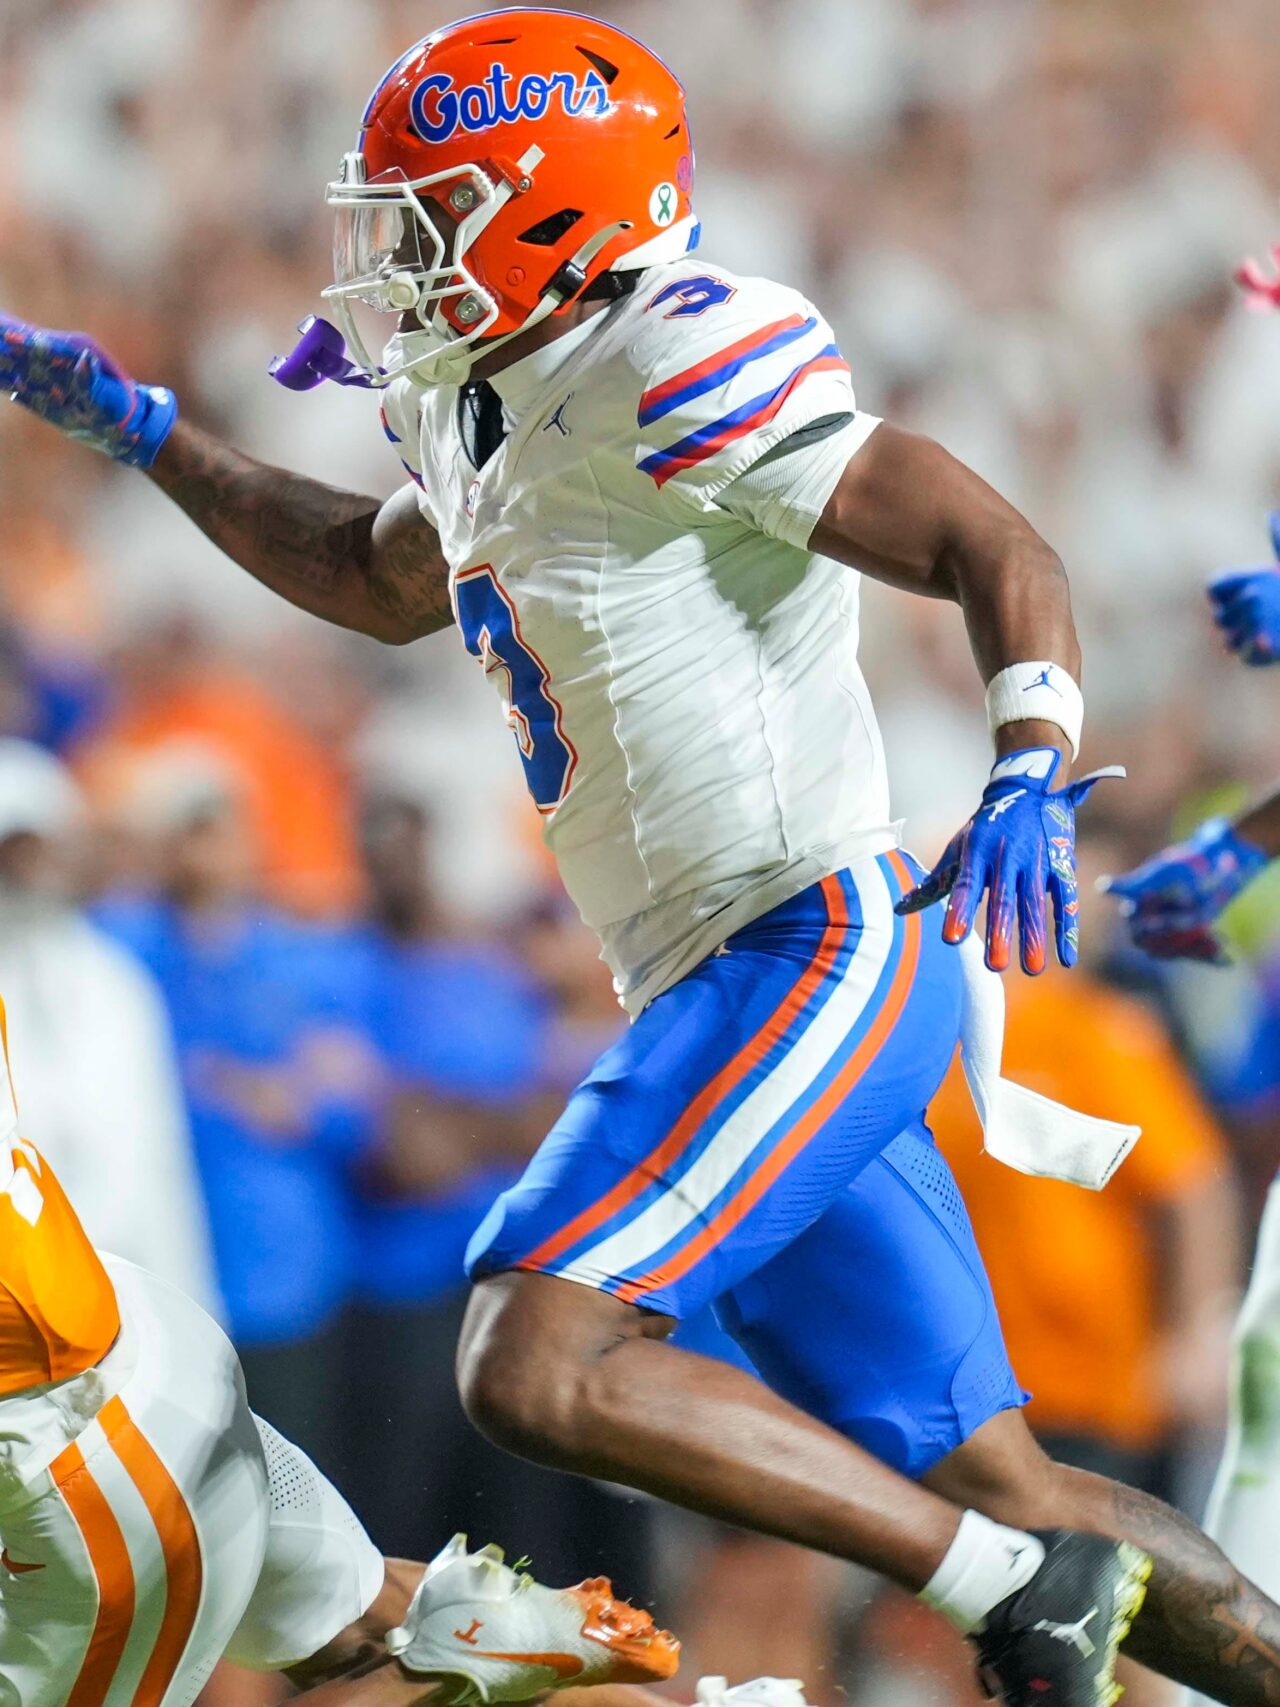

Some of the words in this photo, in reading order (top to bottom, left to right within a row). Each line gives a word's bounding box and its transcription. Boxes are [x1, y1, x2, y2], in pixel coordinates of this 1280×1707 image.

[410, 62, 612, 144] Gators
[644, 275, 738, 320] 3
[453, 1617, 486, 1646] T
